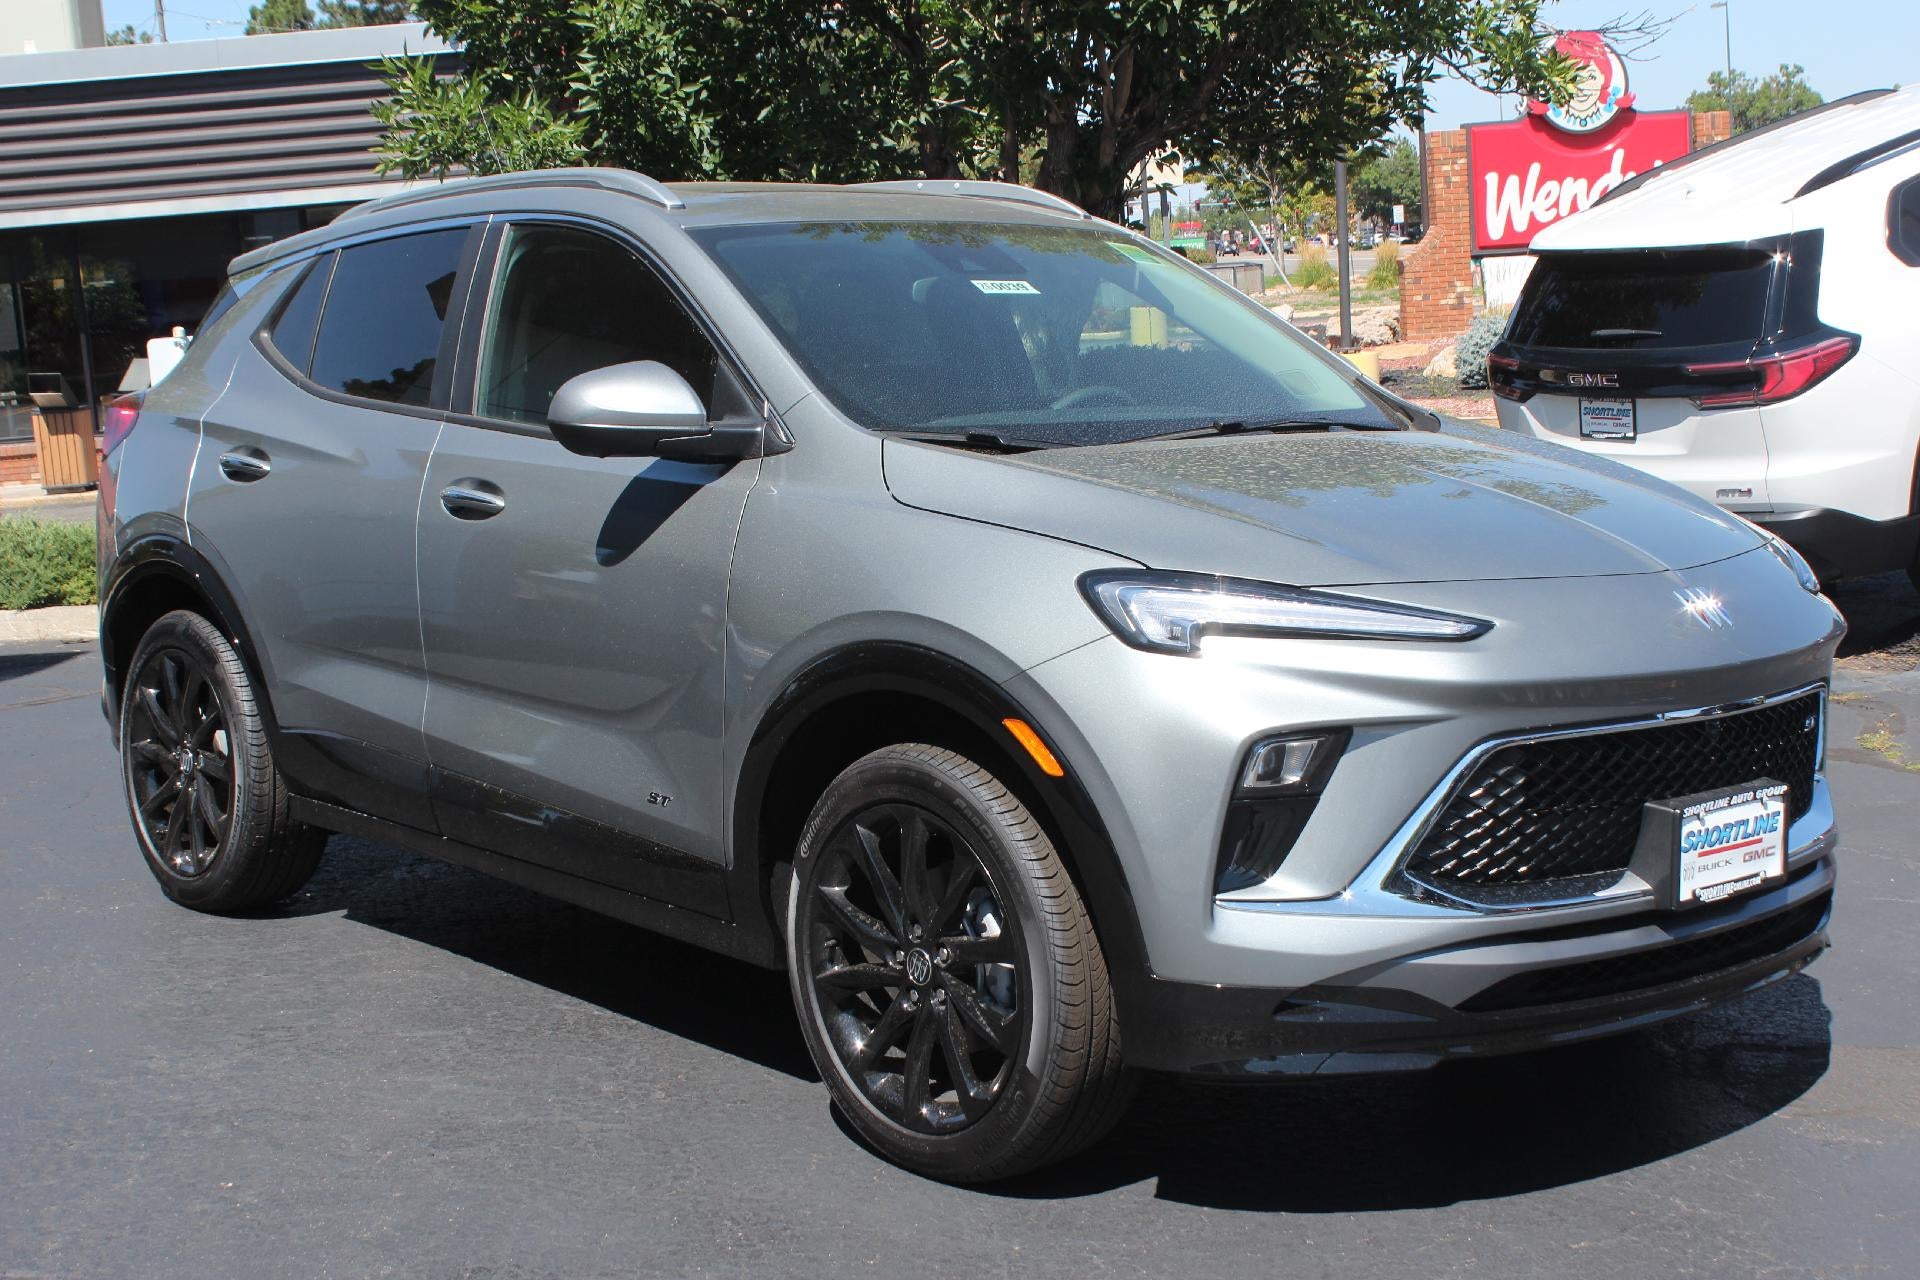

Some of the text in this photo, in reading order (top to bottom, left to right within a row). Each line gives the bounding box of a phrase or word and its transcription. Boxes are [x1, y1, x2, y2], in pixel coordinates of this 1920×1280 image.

[1485, 148, 1663, 240] Wend
[1568, 373, 1619, 387] GMC
[648, 791, 673, 807] ST
[1683, 785, 1787, 817] SHORTLINE AUTO GROUP
[1681, 811, 1781, 853] SHORTLINE
[1698, 845, 1776, 873] BUICK GMC
